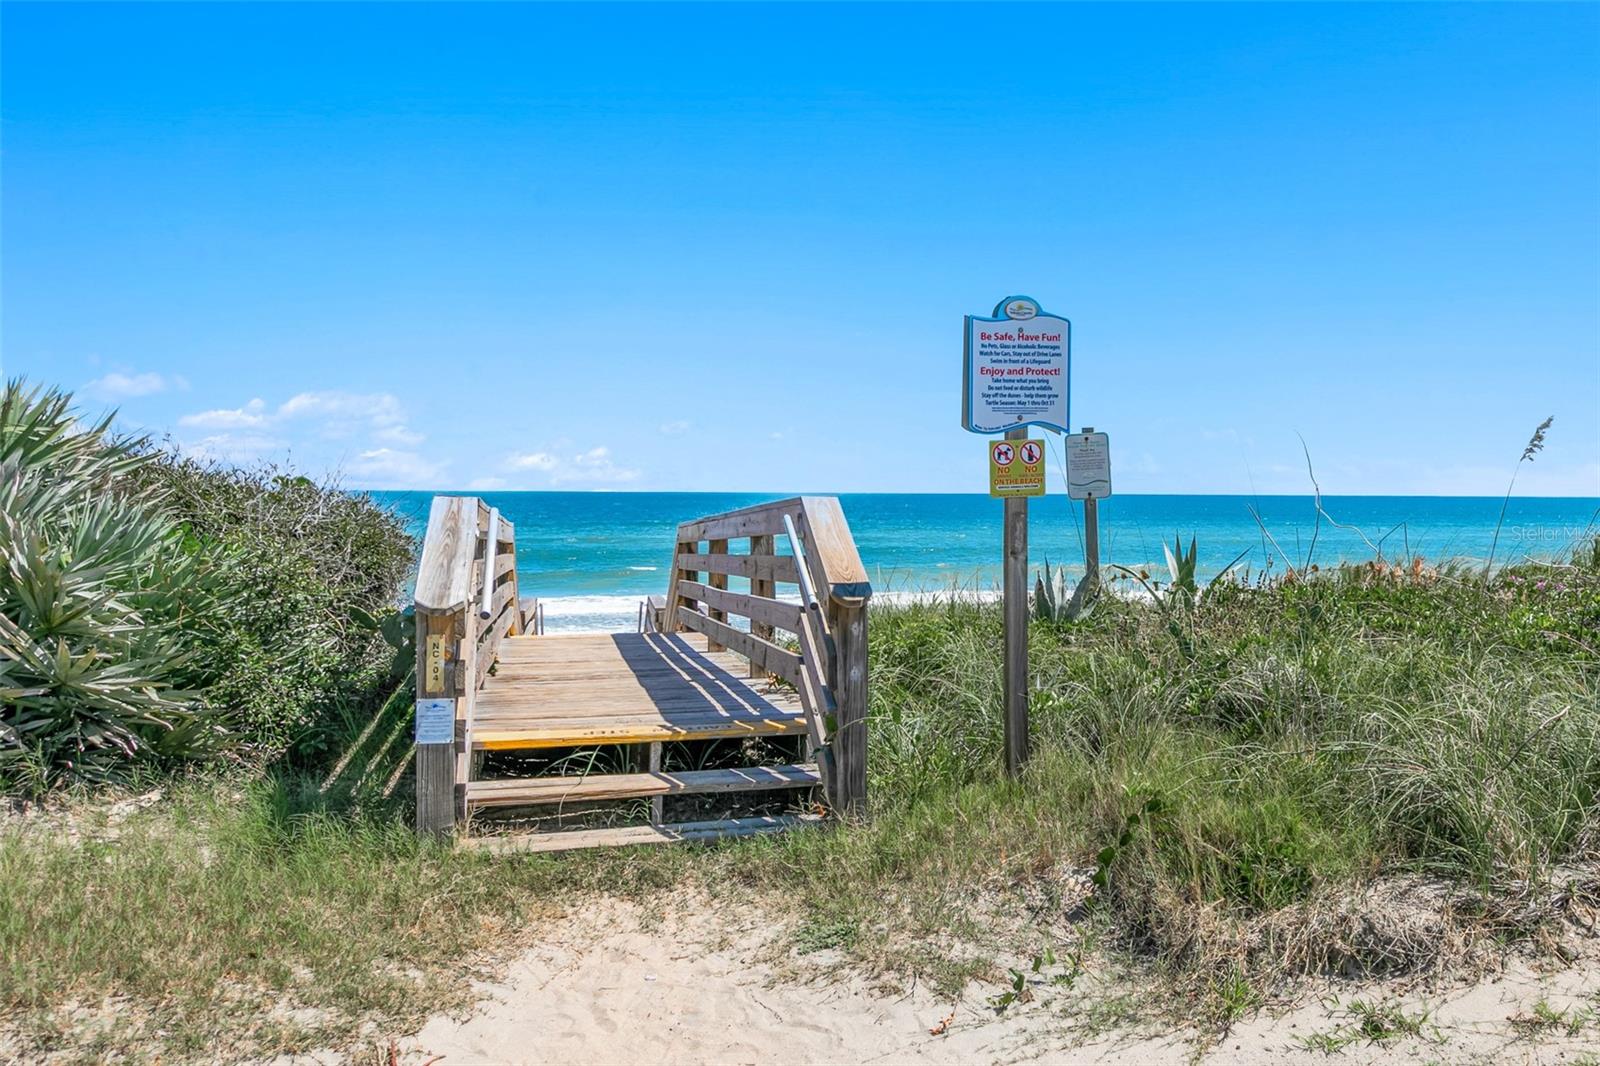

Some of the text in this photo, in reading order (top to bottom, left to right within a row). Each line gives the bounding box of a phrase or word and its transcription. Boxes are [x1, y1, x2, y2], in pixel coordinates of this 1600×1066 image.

[980, 332, 992, 340] Be
[994, 332, 1015, 341] Safe,
[980, 367, 1005, 377] Enjoy
